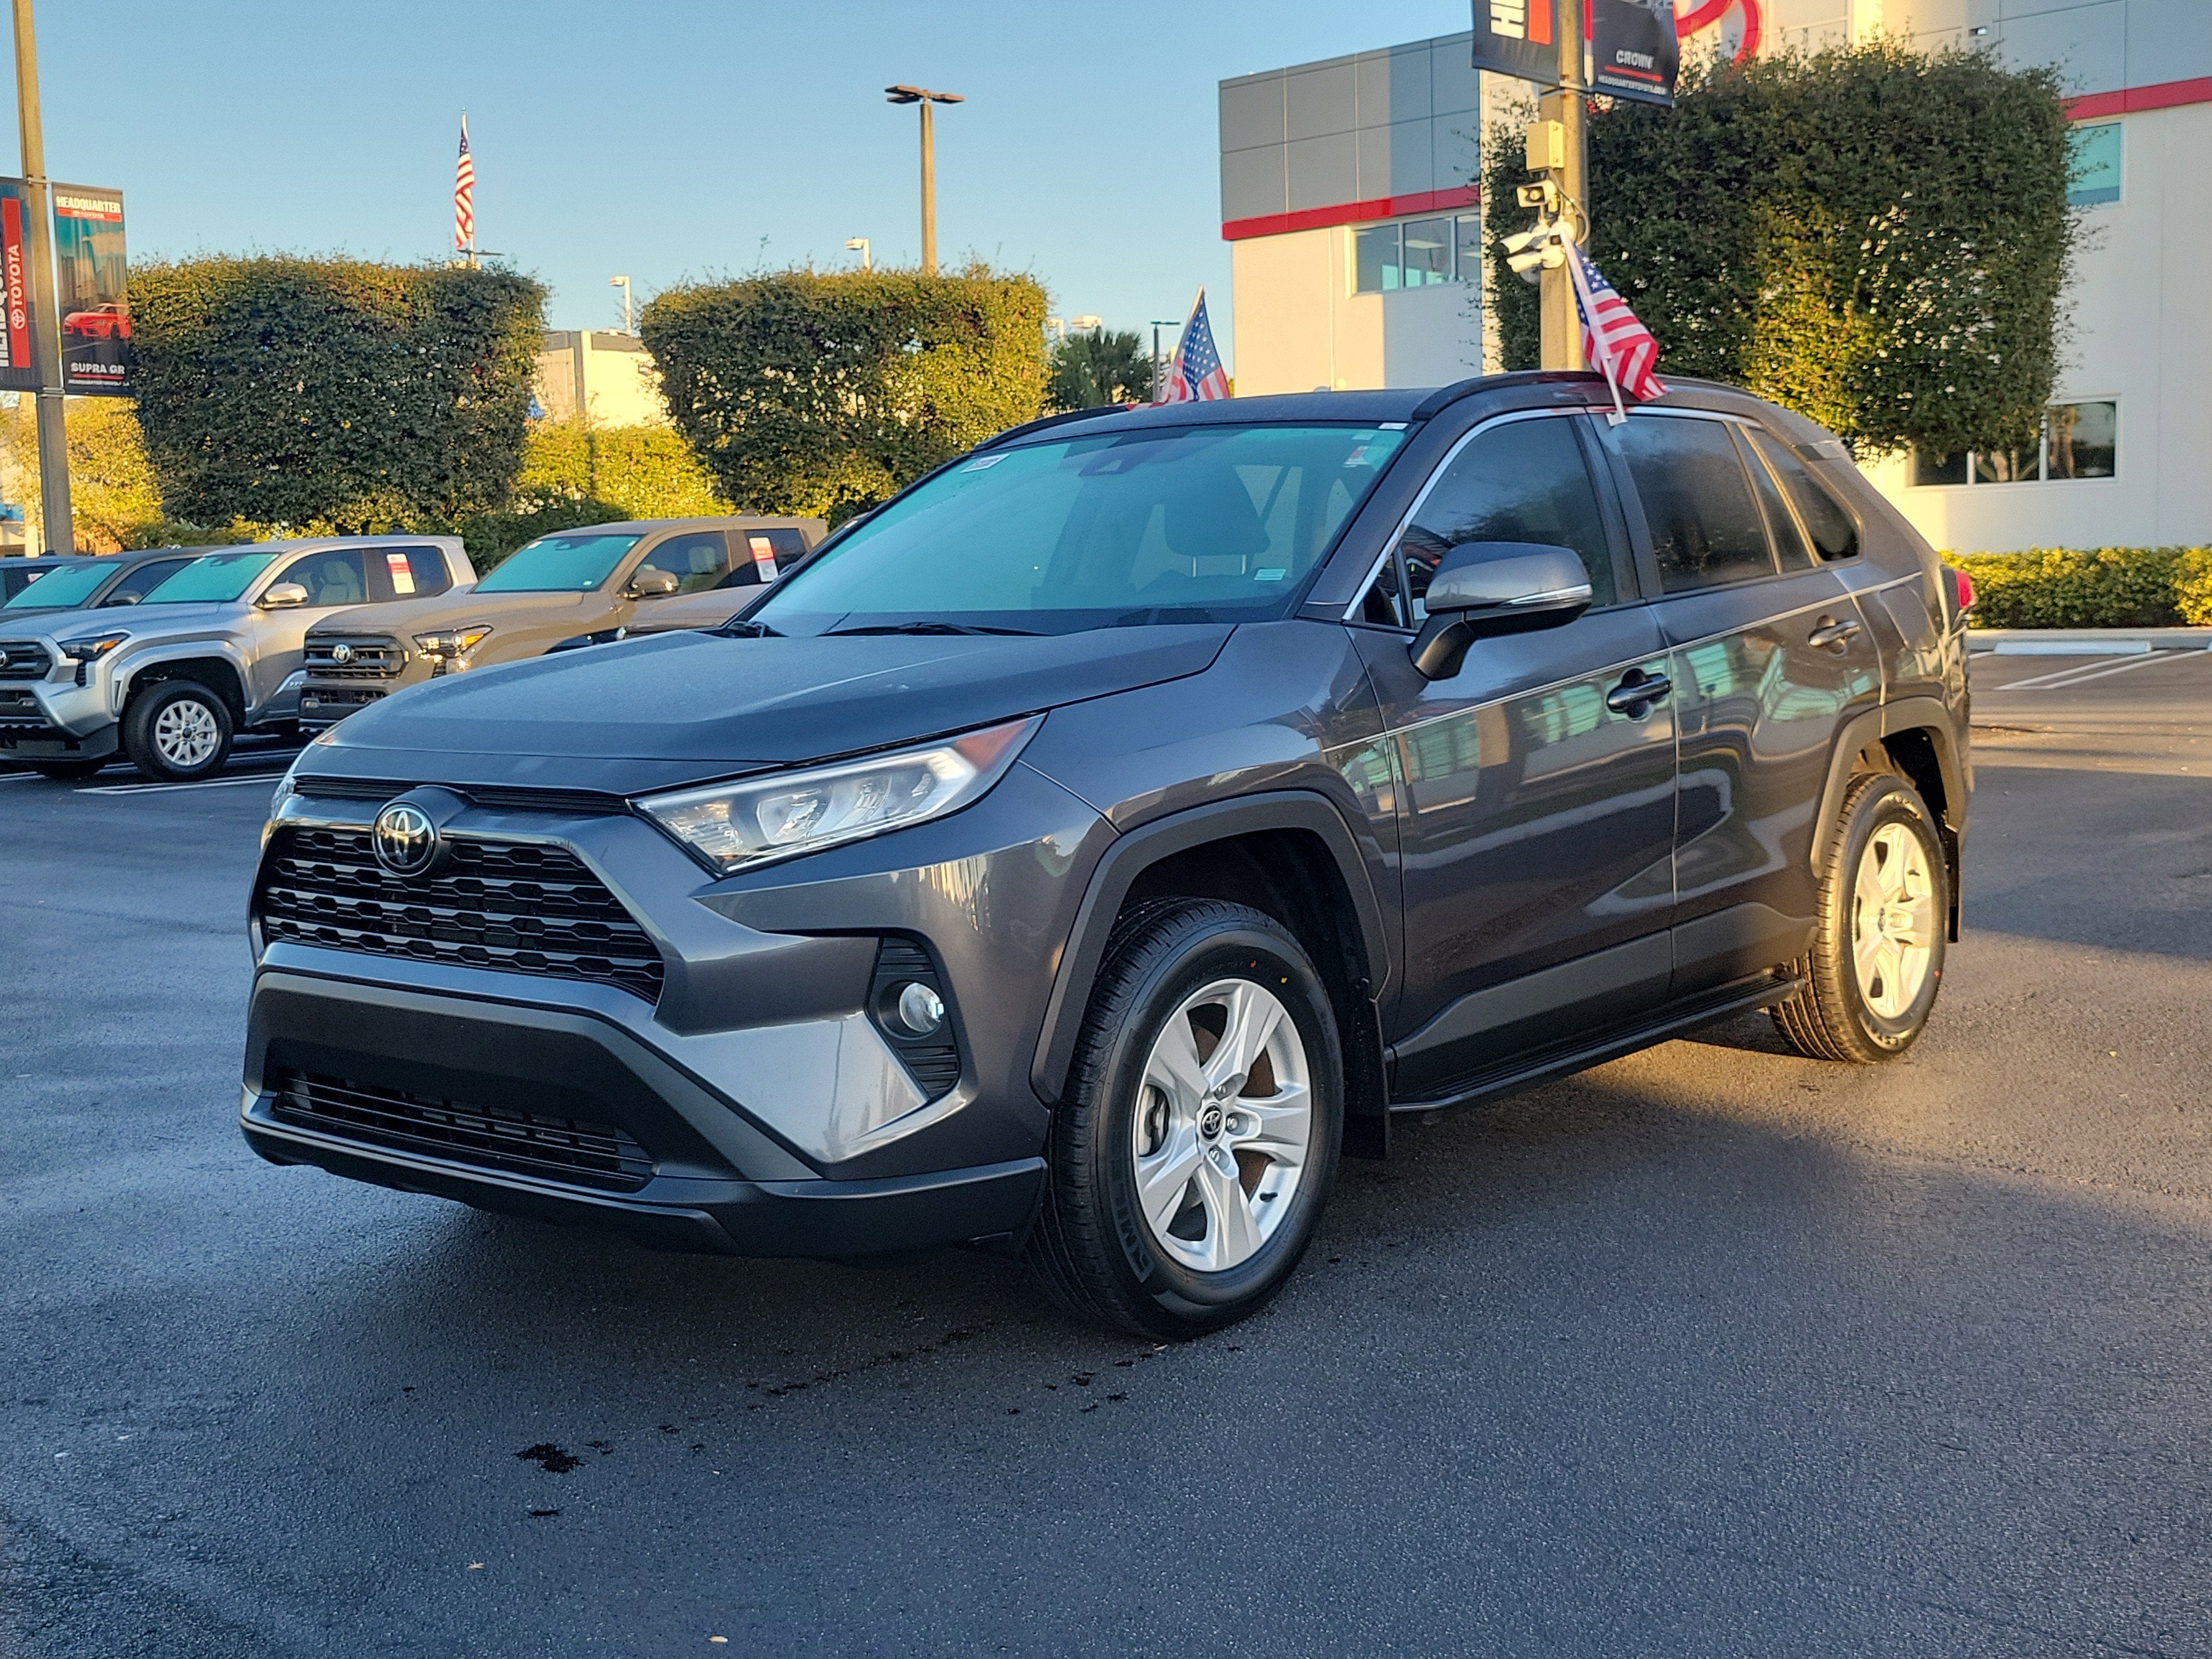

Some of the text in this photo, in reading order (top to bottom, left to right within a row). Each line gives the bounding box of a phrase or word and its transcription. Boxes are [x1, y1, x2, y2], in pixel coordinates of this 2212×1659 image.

[1616, 50, 1654, 70] CROWN
[56, 196, 121, 214] HEADQUARTER
[8, 244, 23, 308] TOYOTA
[71, 362, 125, 374] SUPRA GR
